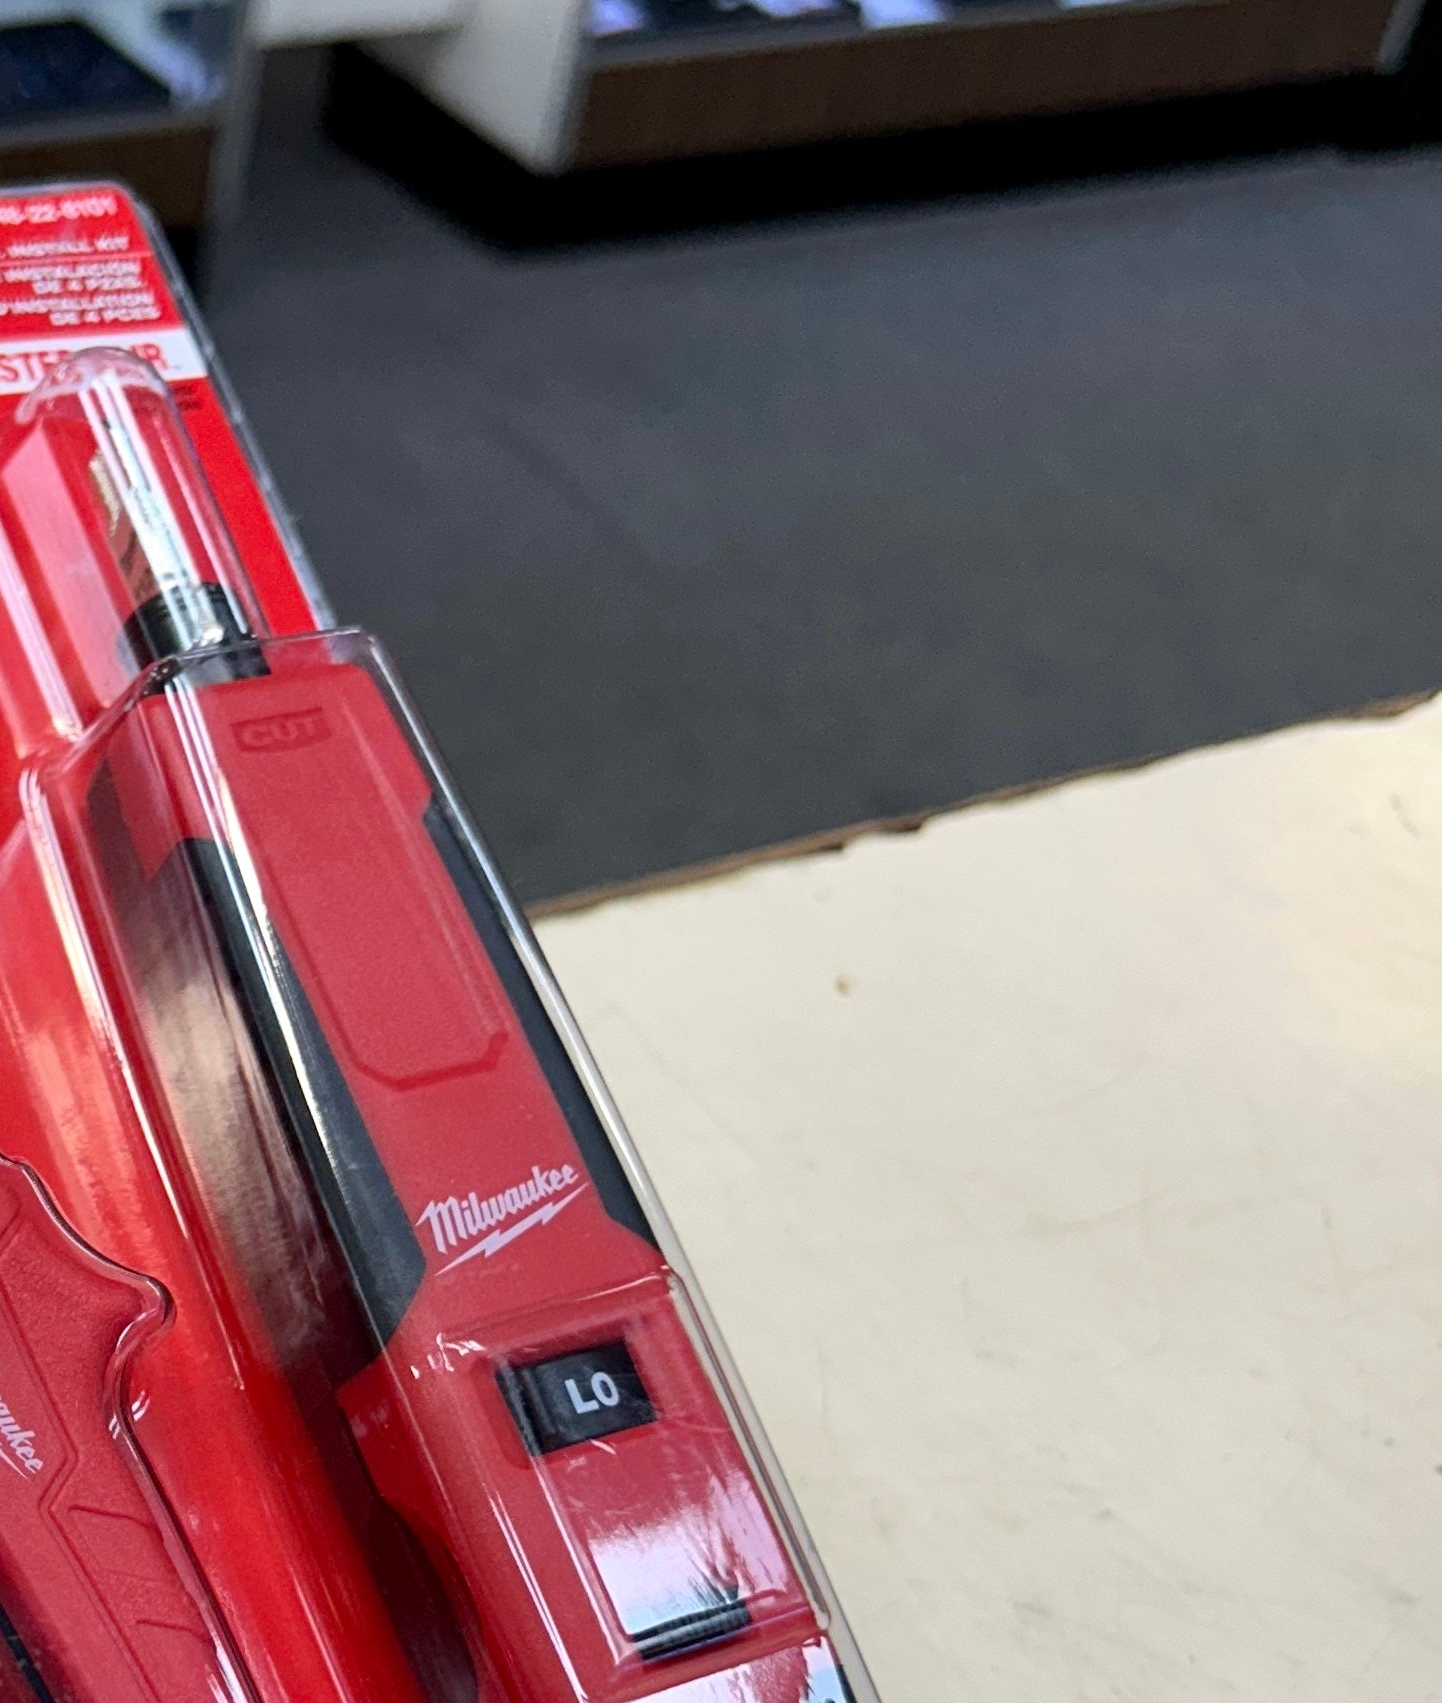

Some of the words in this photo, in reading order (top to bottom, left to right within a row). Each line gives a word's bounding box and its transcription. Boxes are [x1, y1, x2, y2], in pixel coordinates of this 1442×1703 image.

[243, 715, 322, 748] CUT
[415, 1164, 579, 1254] Milwaukee
[564, 1371, 620, 1415] LO
